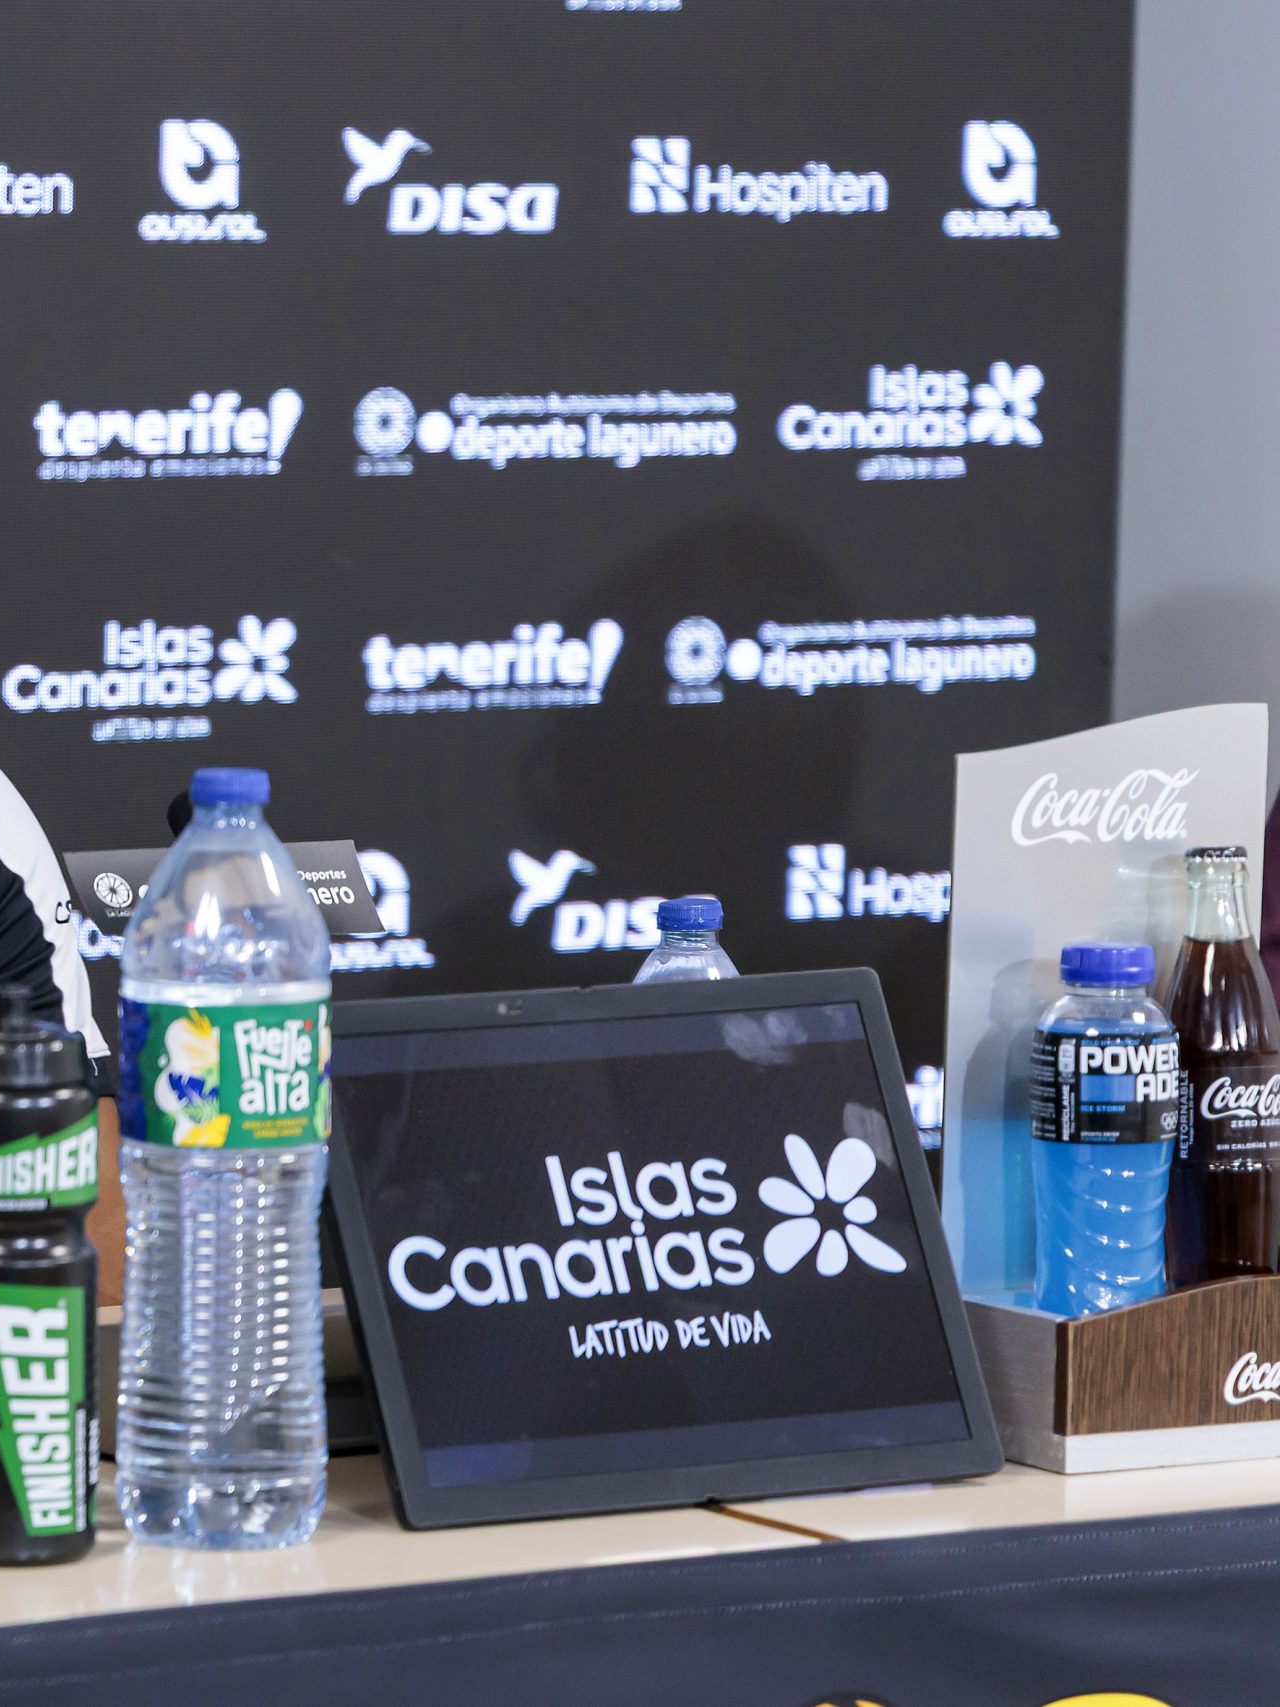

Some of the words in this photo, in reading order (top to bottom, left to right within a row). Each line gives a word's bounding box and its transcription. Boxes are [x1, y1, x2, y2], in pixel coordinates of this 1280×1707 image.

[693, 160, 888, 222] Hospiten
[868, 364, 969, 414] Islas
[33, 388, 303, 475] tenerife!
[451, 414, 586, 470] deporte
[586, 412, 737, 469] lagunero
[776, 403, 968, 450] Canarias
[104, 619, 214, 672] Islas
[759, 641, 890, 696] deporte
[890, 637, 1037, 695] lagunero
[2, 664, 213, 713] Canarias
[1011, 767, 1201, 847] Coca-Cola
[306, 885, 355, 905] nero
[847, 866, 951, 923] Hosp
[552, 895, 719, 953] DIS
[1080, 1043, 1180, 1074] POWER
[1136, 1071, 1180, 1103] ADE
[1179, 1069, 1189, 1159] RETORNABLE
[1230, 1119, 1258, 1129] ZERO
[544, 1151, 738, 1236] Islas
[387, 1226, 756, 1311] Canarias
[569, 1317, 669, 1358] LATITUD
[674, 1316, 711, 1349] DE
[710, 1309, 772, 1347] VIDA
